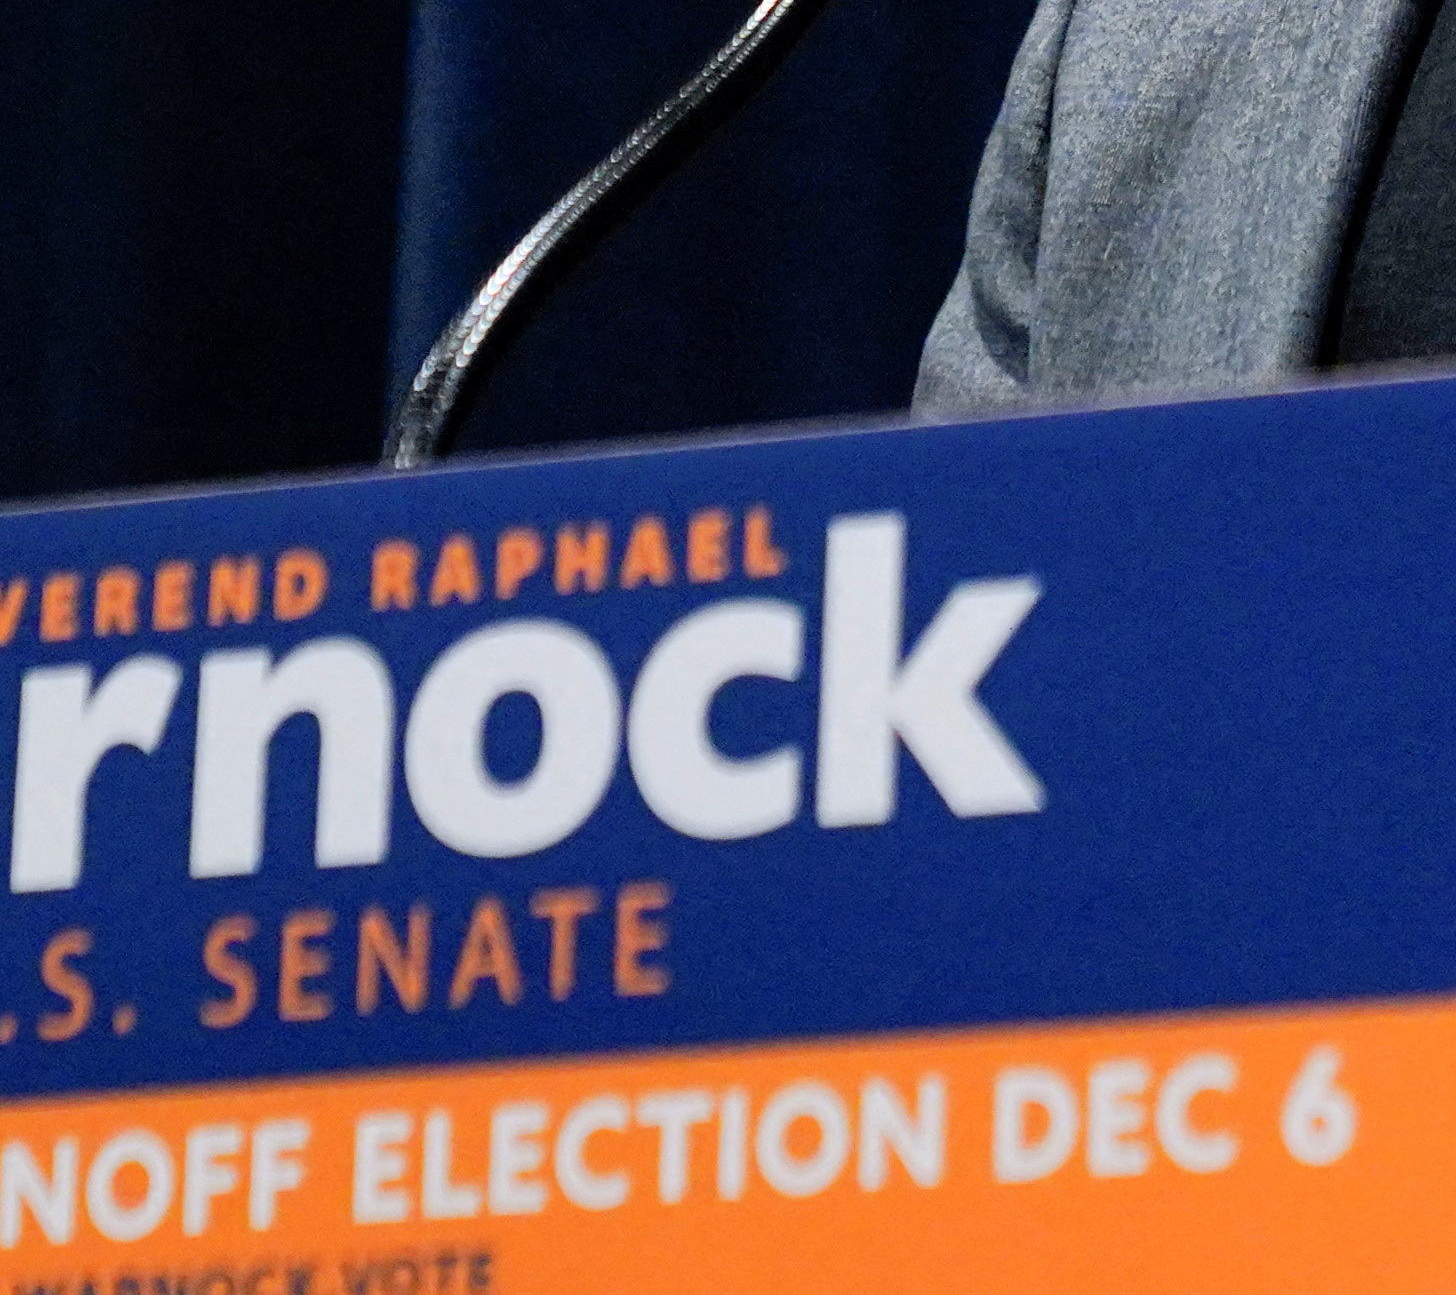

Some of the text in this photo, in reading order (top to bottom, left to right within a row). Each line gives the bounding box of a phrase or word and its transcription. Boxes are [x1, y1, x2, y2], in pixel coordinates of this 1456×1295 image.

[370, 506, 786, 612] RAPHAEL
[198, 882, 673, 1029] SENATE
[350, 1075, 948, 1225] ELECTION
[991, 1053, 1239, 1184] DEC
[1280, 1045, 1360, 1167] 6
